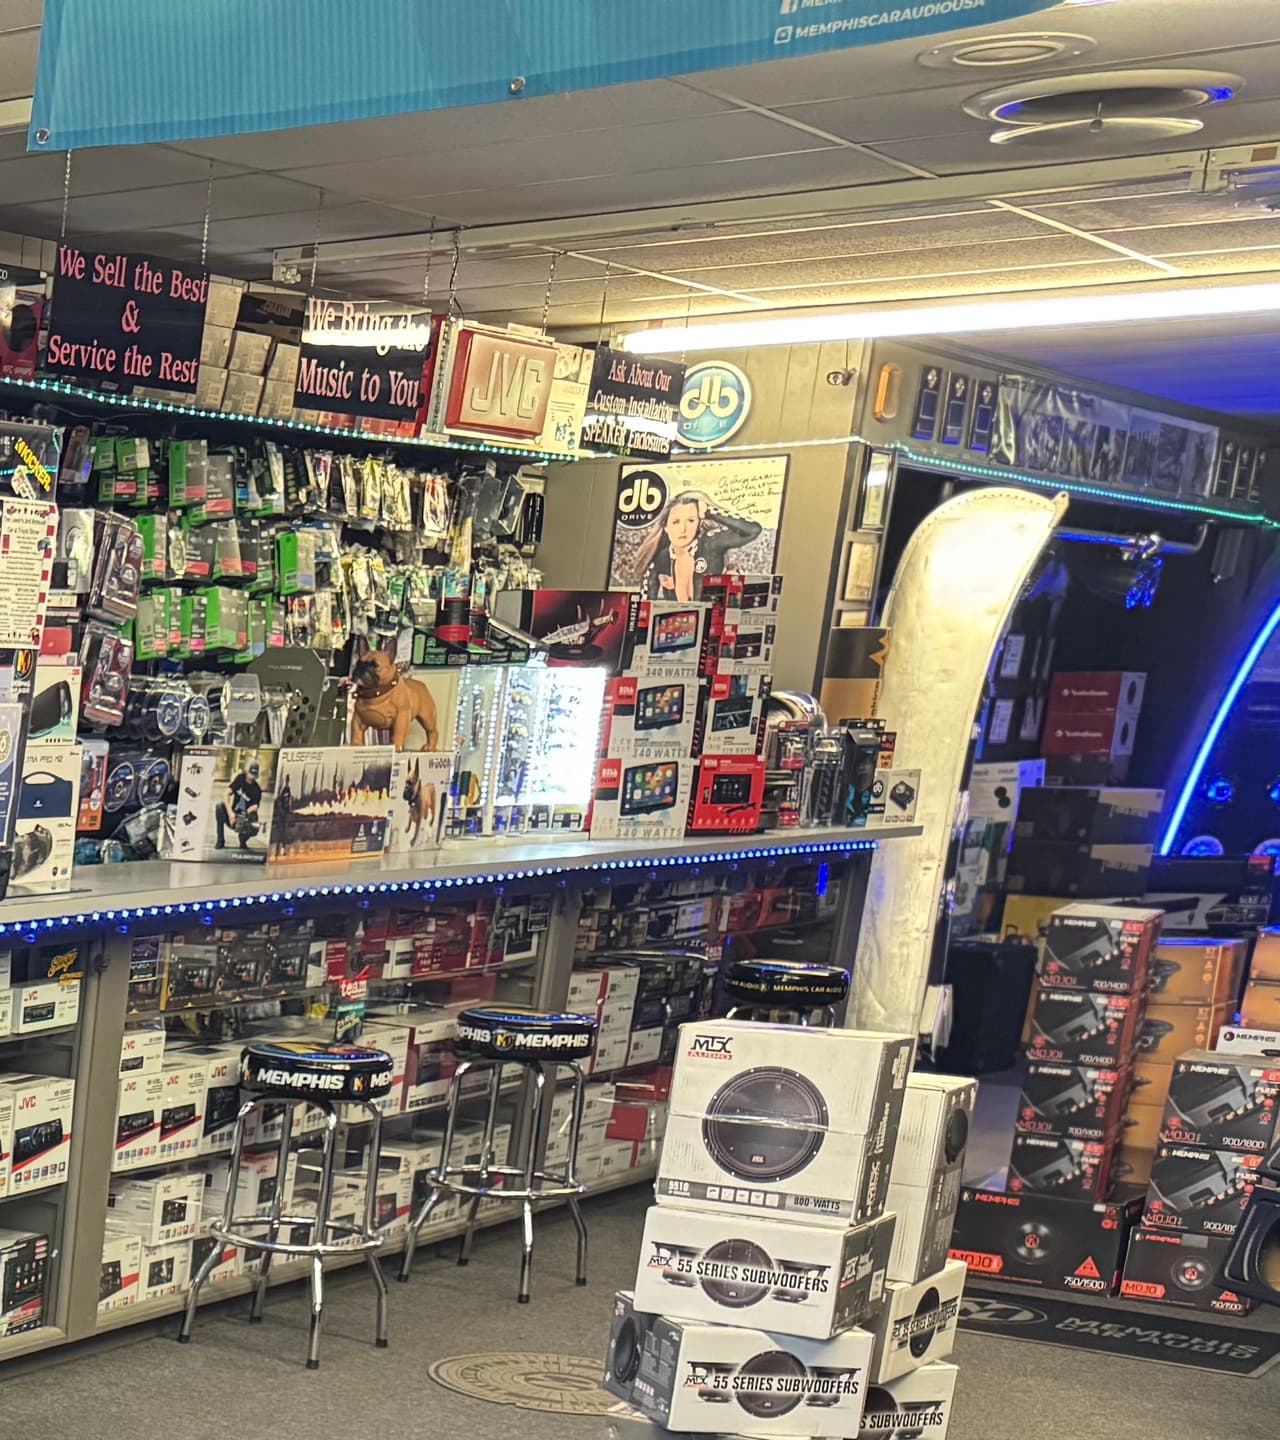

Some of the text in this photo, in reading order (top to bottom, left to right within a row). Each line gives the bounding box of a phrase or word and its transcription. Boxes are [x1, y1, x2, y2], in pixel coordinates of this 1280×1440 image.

[59, 245, 208, 304] We Sell the Best
[121, 300, 141, 334] &
[308, 296, 393, 351] We Bring
[48, 335, 116, 372] Service
[123, 345, 154, 378] the
[159, 352, 198, 386] Rest
[297, 358, 420, 408] Music to You
[472, 350, 542, 419] JVC
[608, 359, 672, 393] Ask About Our
[594, 390, 629, 414] Custom
[680, 376, 740, 419] db
[618, 478, 661, 513] db
[621, 513, 654, 521] DRIVE
[23, 990, 38, 1003] JVC
[123, 1040, 136, 1051] JVC
[515, 1032, 590, 1049] MEMPHIS
[691, 1034, 734, 1053] MTX
[166, 1075, 179, 1086] JVC
[211, 1065, 228, 1078] JVC
[256, 1067, 345, 1091] MEMPHIS
[123, 1081, 137, 1092] JVC
[18, 1096, 37, 1110] JVC
[677, 1258, 830, 1294] 55 SERIES SUBWOOFERS
[713, 1375, 859, 1396] 55 SERIES SUBWOOFERS
[869, 1412, 944, 1430] SUBWOOFERS
